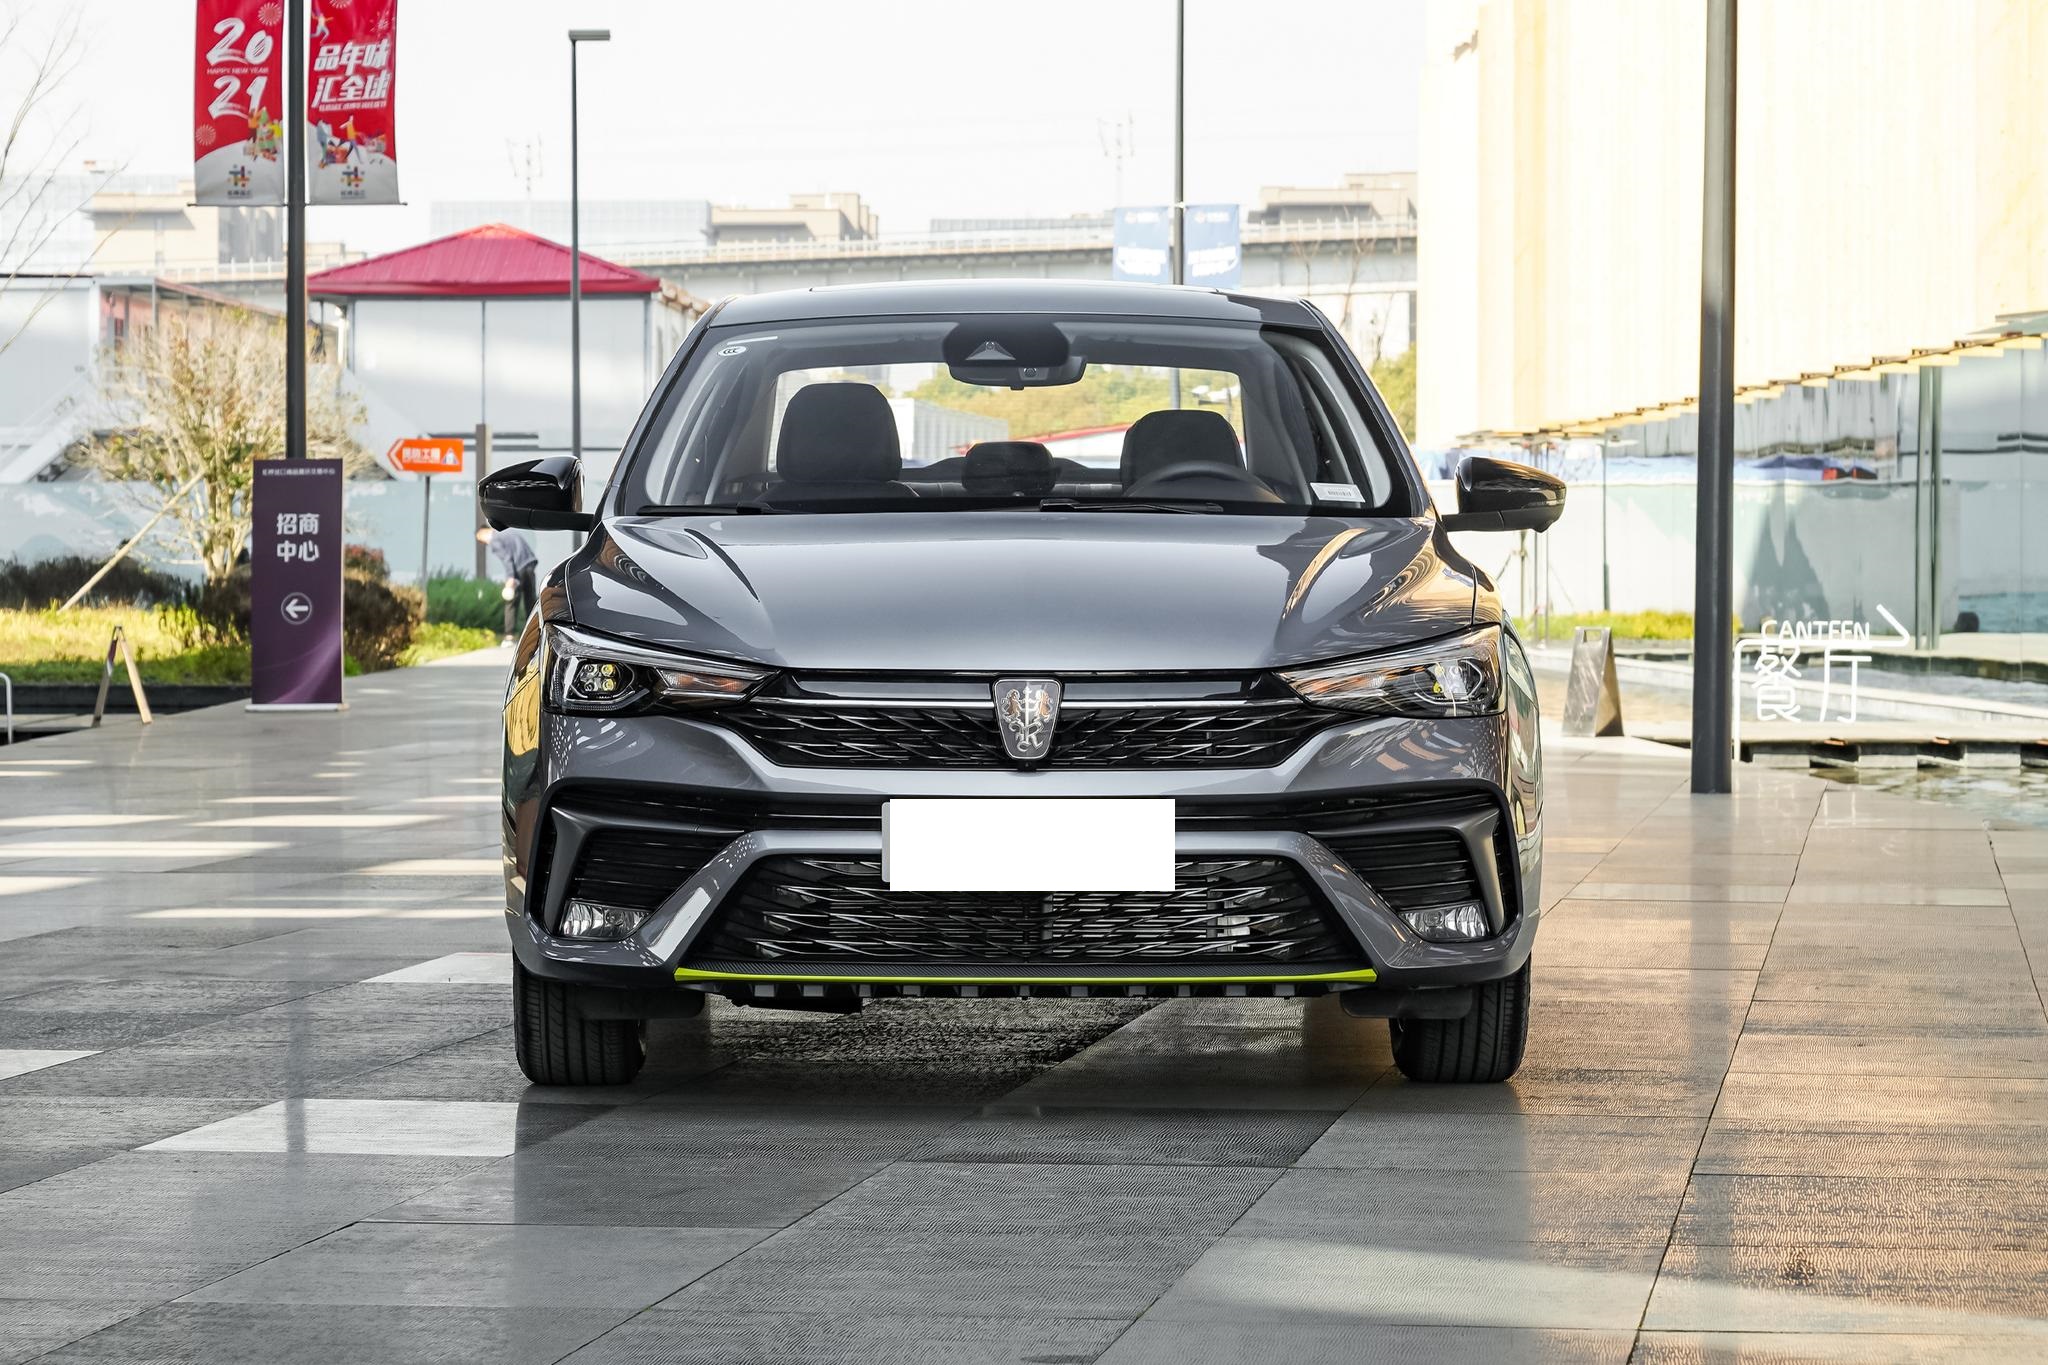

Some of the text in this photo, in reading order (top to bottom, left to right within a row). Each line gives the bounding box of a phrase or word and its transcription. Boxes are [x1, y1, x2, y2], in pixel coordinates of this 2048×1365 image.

[206, 17, 274, 66] 20
[314, 38, 391, 75] 品年味
[207, 75, 268, 120] 21
[311, 70, 392, 109] 汇全球
[276, 513, 320, 535] 招商
[276, 540, 320, 563] 中心
[1761, 620, 1870, 641] CANTEEN
[1752, 643, 1872, 722] 餐厅
